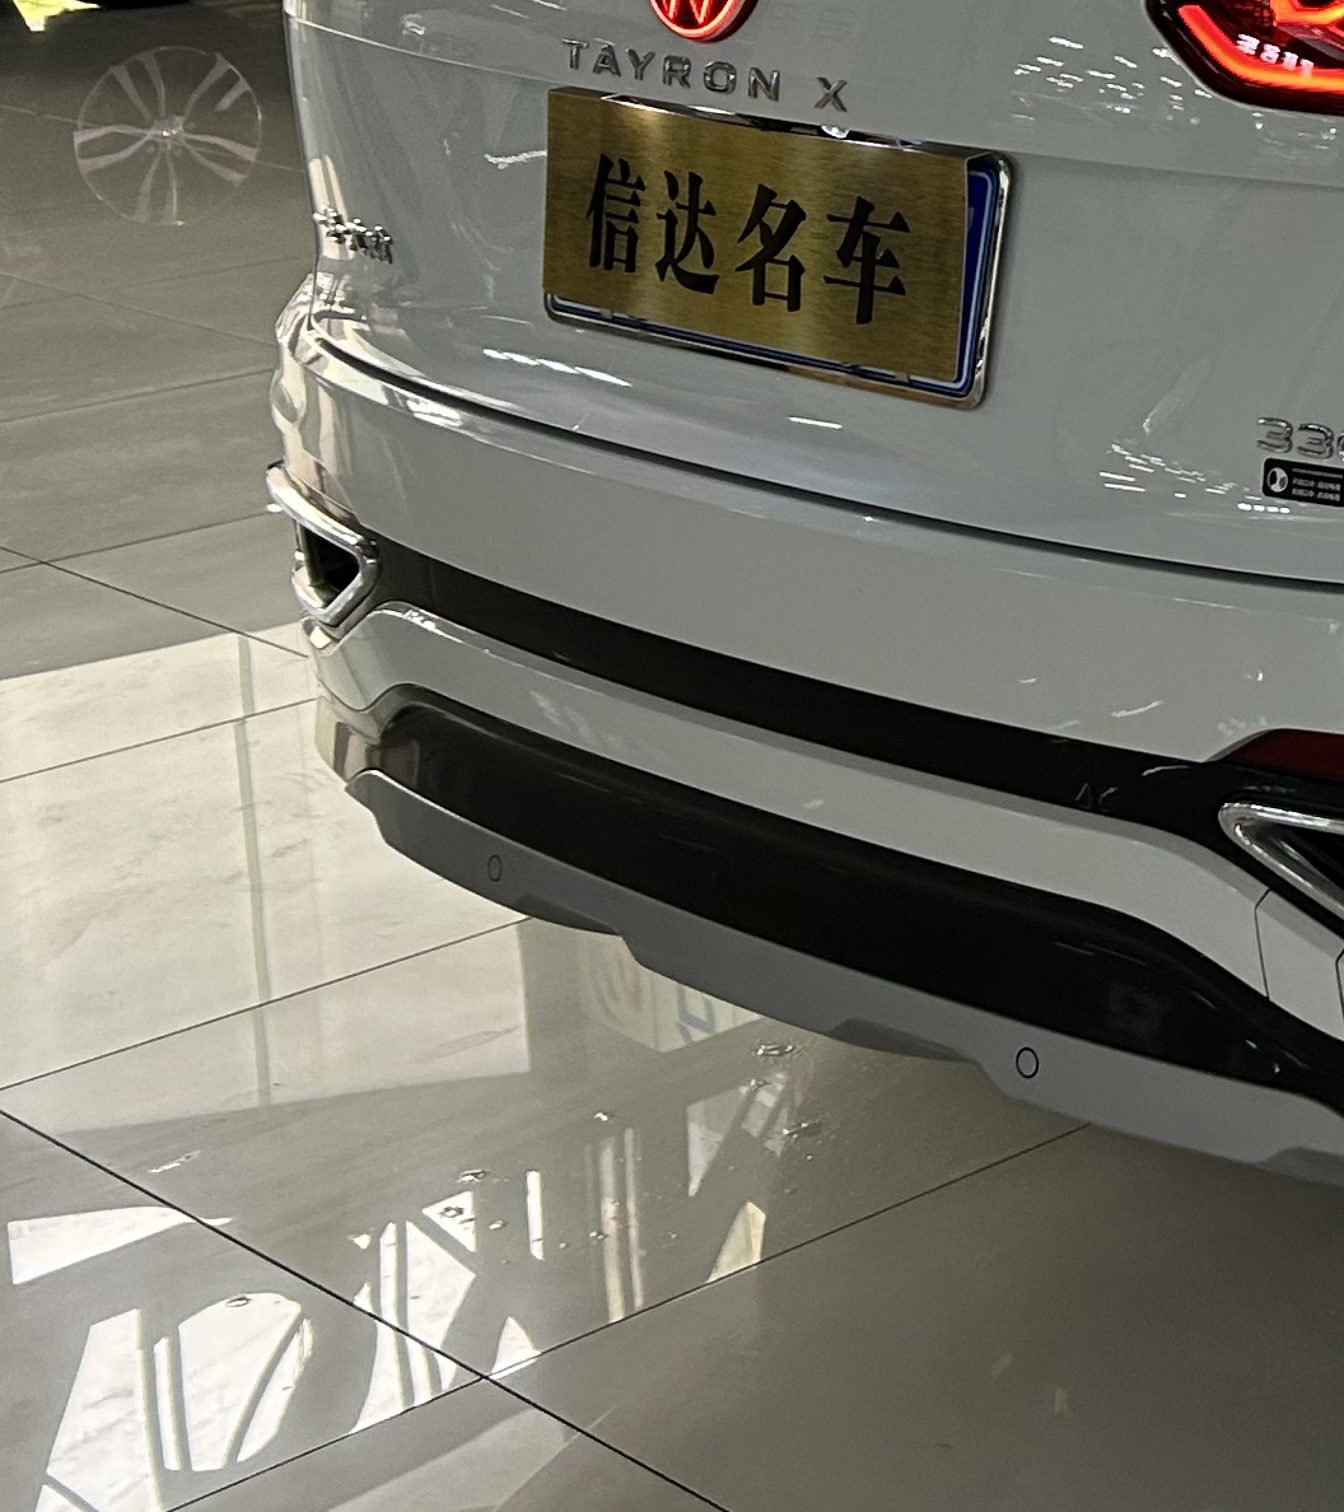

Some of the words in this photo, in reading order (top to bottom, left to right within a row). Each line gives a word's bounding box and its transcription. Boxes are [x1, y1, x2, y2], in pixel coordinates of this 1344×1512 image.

[560, 37, 781, 103] TAYRON
[814, 76, 849, 113] X
[585, 153, 910, 327] 信达名车
